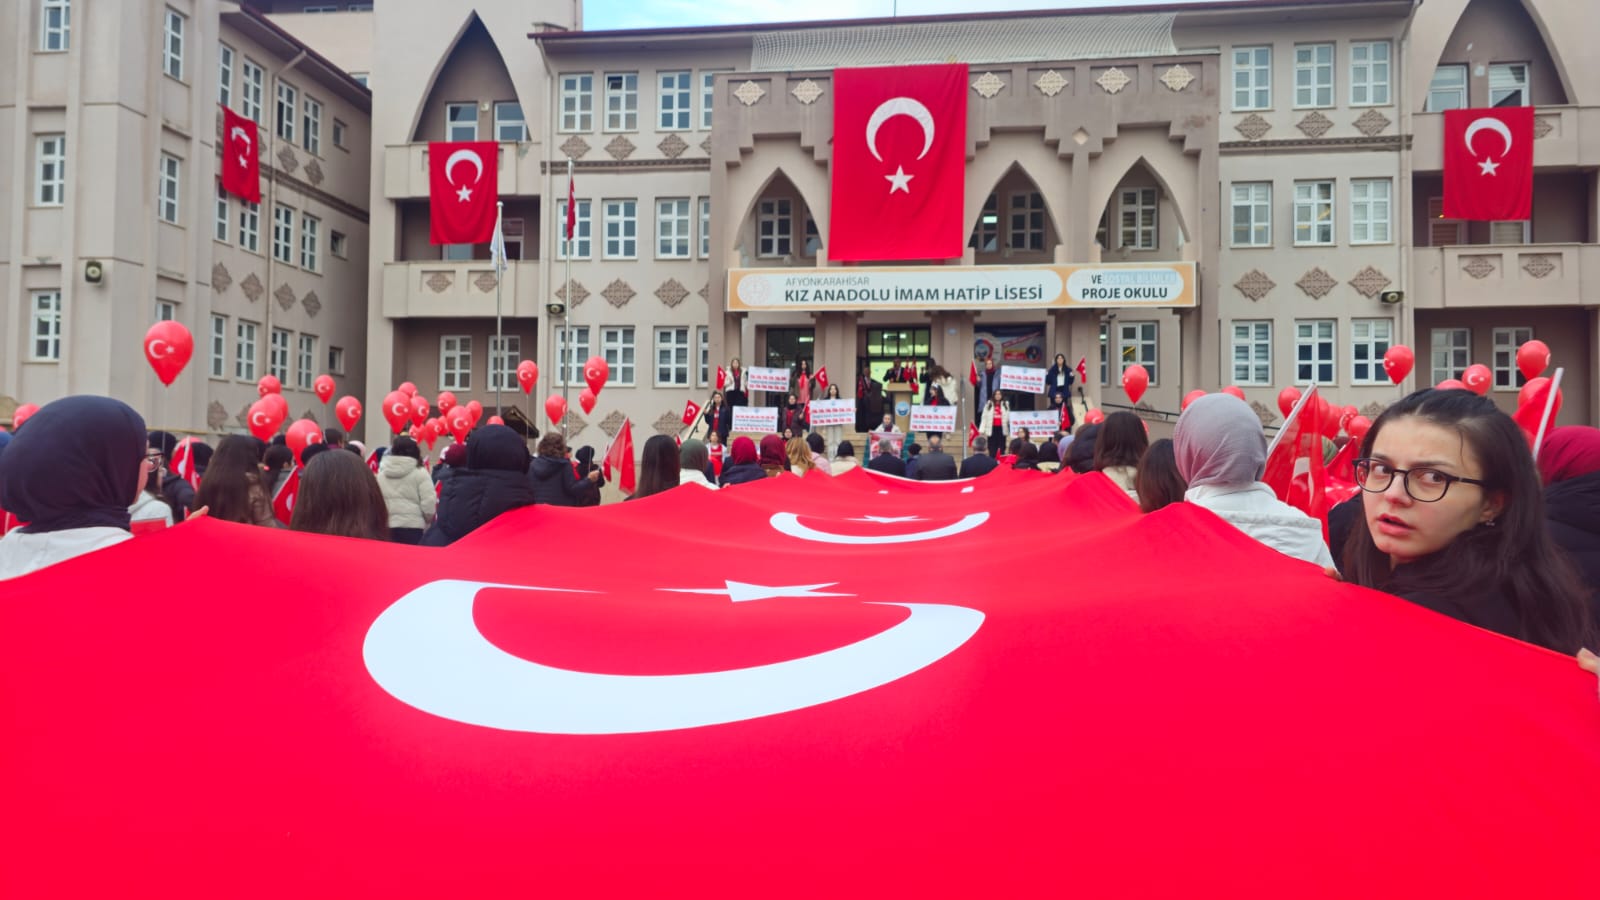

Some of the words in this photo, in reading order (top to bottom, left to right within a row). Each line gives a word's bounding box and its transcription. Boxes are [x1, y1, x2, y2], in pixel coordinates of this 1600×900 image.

[1091, 274, 1103, 285] VE
[784, 289, 809, 302] KIZ
[812, 288, 890, 302] ANADOLU
[894, 285, 940, 301] İMAM
[944, 284, 991, 301] HATİP
[995, 283, 1043, 300] LİSESİ
[1082, 288, 1121, 299] PROJE
[1124, 287, 1168, 298] OKULU
